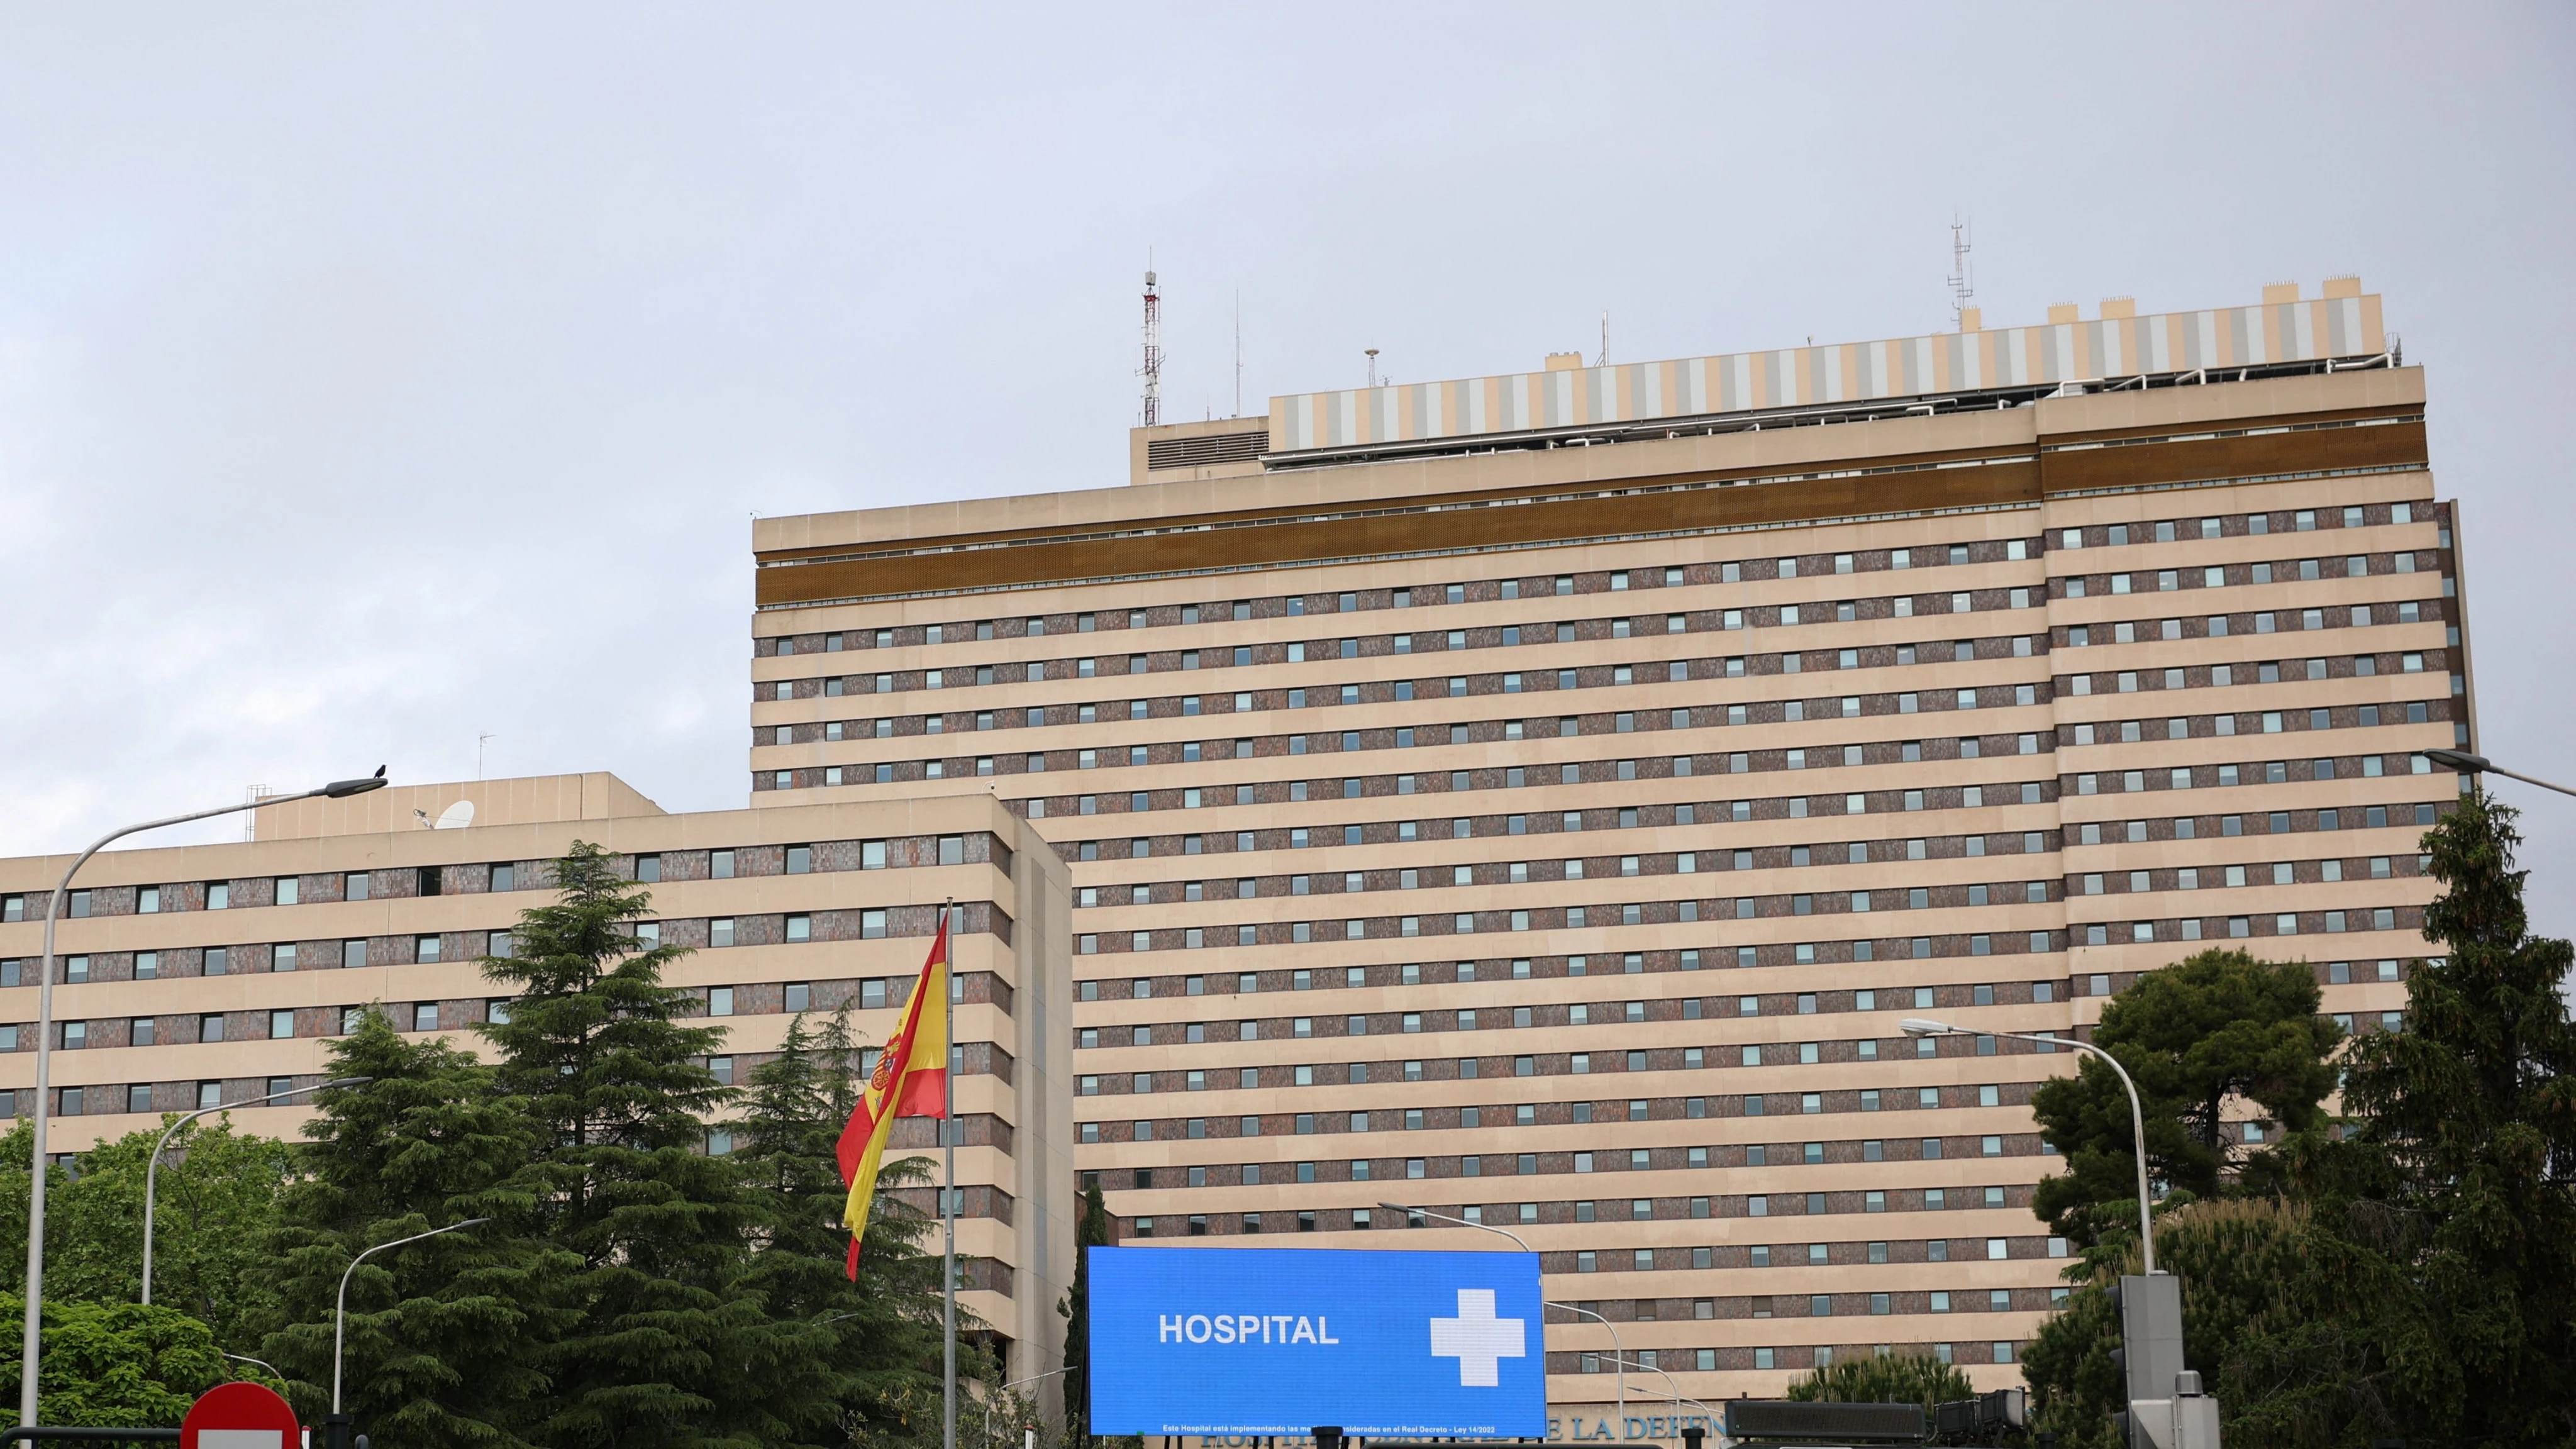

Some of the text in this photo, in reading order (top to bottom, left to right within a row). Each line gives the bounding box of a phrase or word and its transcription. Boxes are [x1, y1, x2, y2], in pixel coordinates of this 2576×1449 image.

[1160, 1314, 1339, 1344] HOSPITAL
[1181, 1424, 1211, 1433] Hospital
[1230, 1425, 1286, 1433] implementando
[1572, 1418, 1614, 1440] LA
[1624, 1415, 1726, 1440] DEFEN
